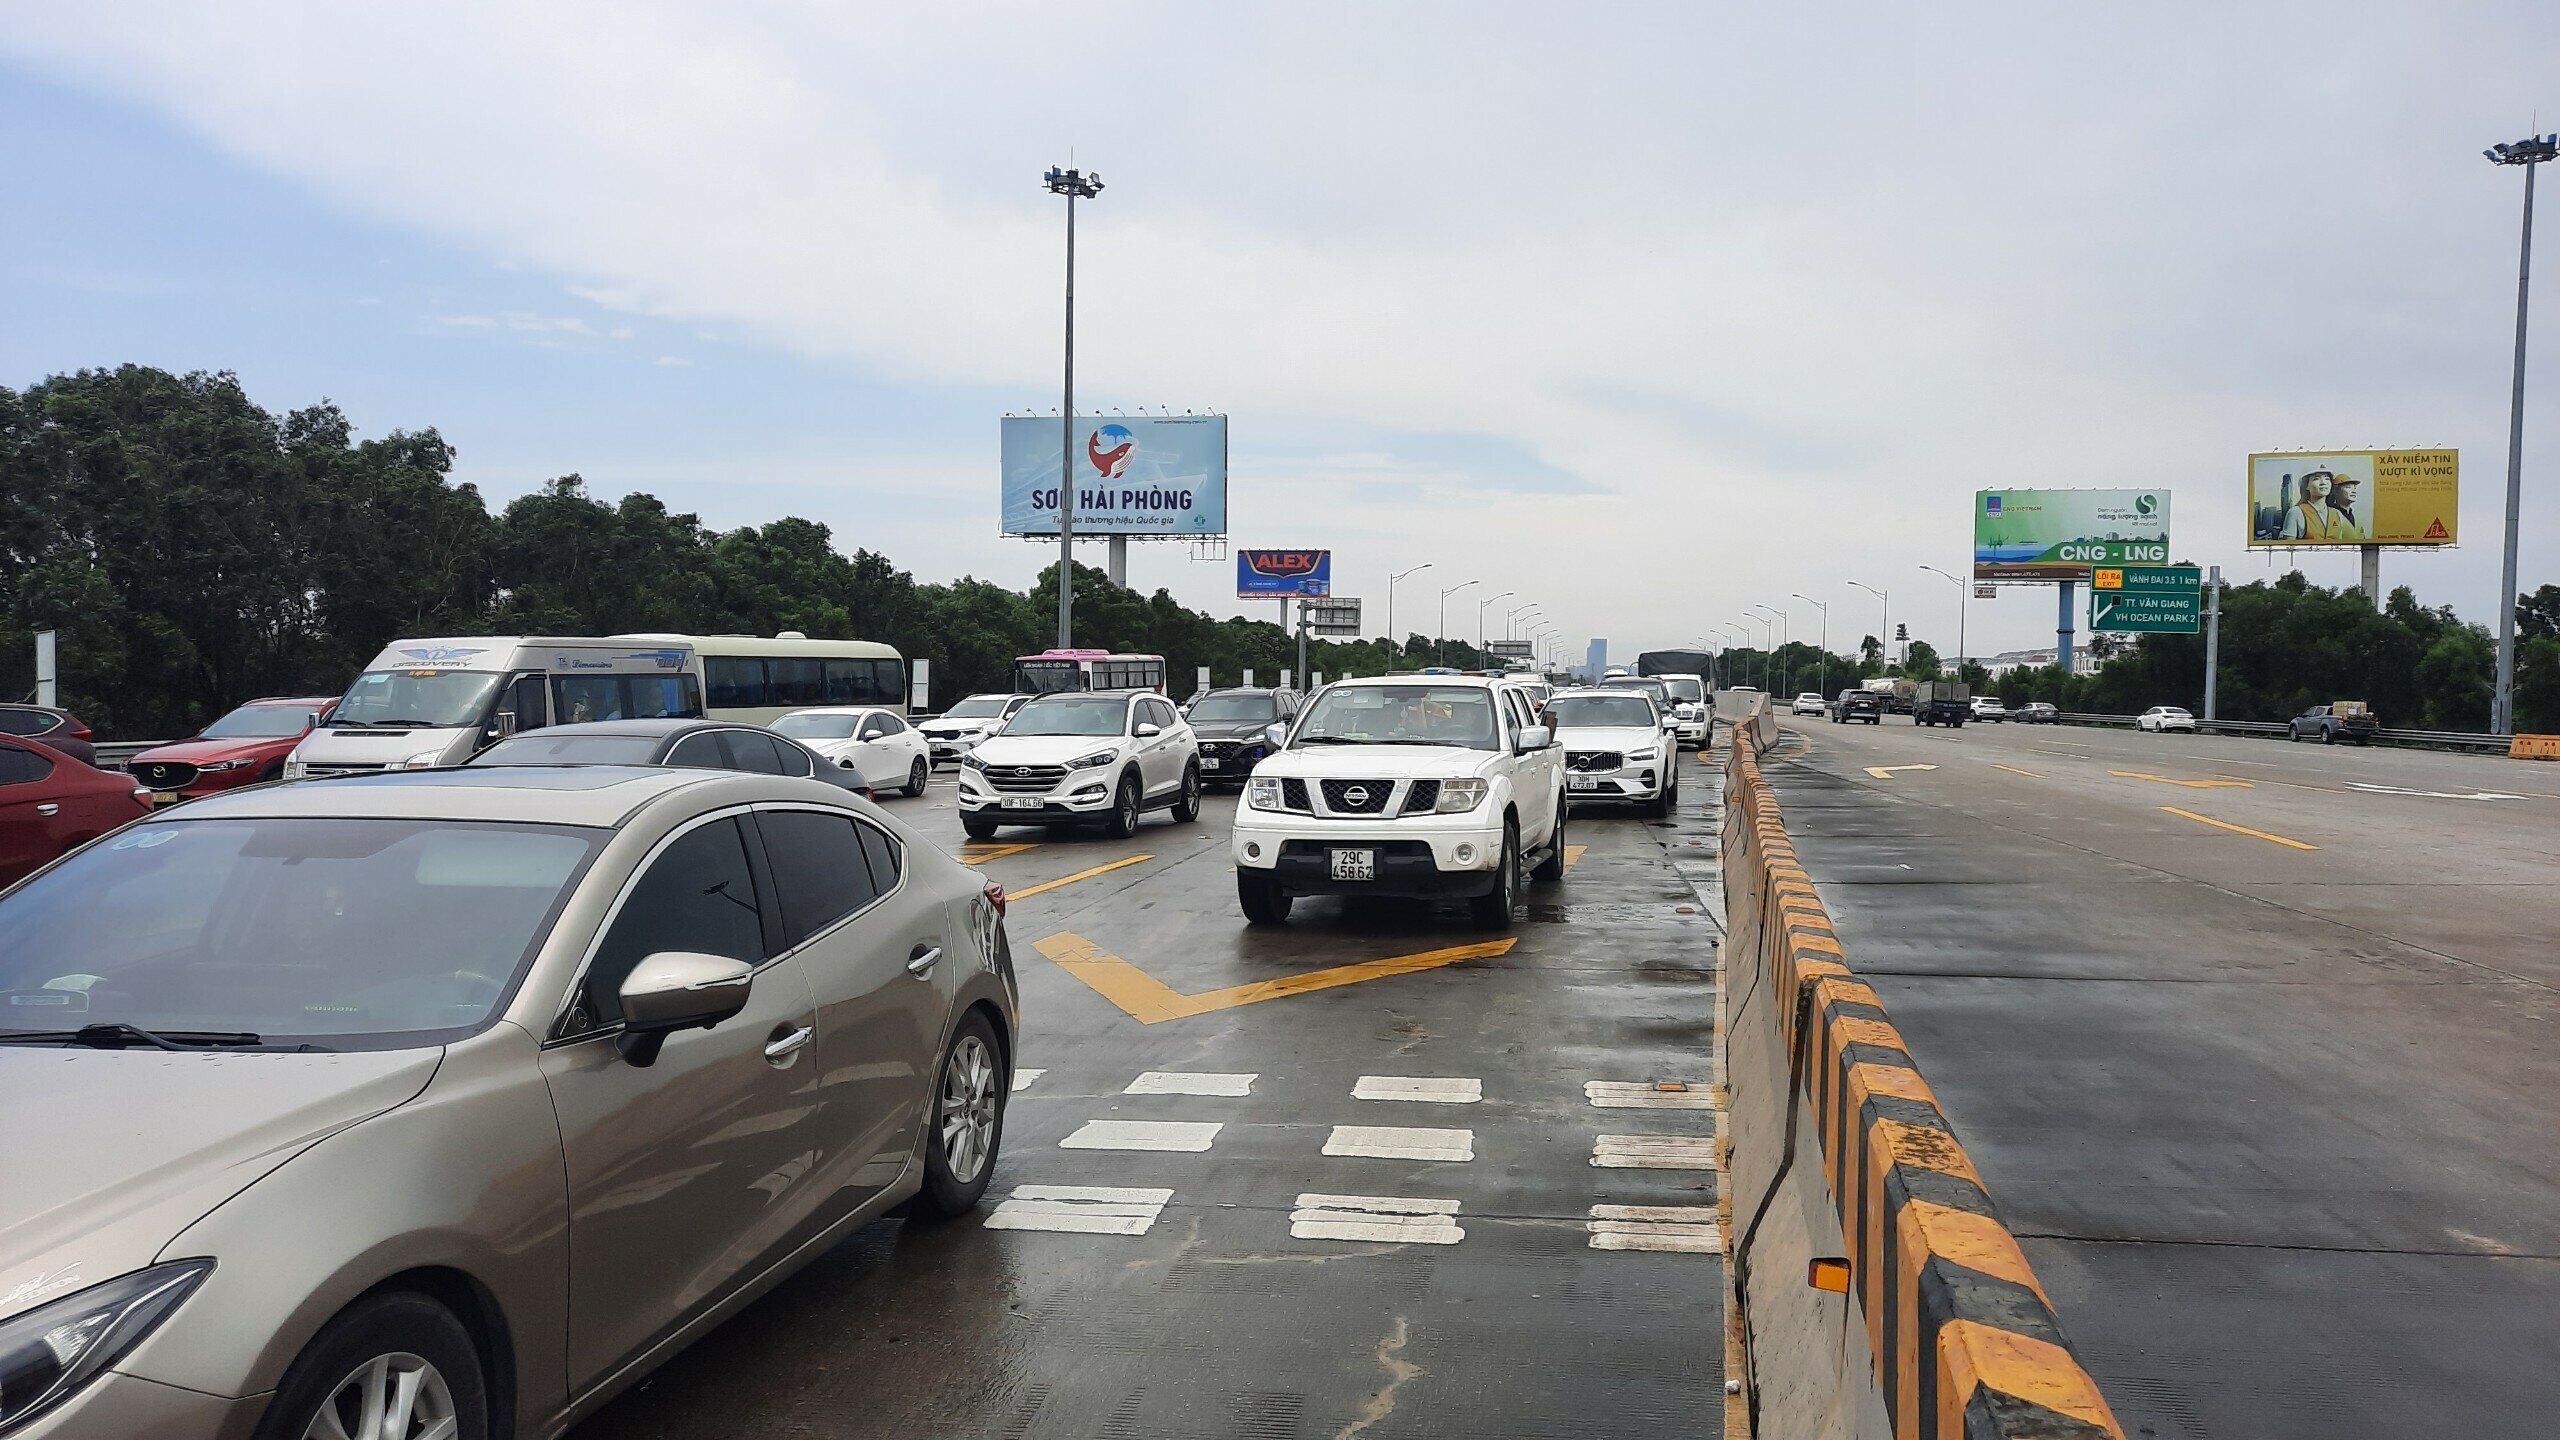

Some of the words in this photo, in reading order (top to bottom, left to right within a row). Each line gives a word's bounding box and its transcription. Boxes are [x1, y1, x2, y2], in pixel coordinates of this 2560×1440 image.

[2433, 455, 2451, 463] TIN
[1032, 487, 1073, 510] SƠ
[1080, 484, 1115, 510] HẢI
[1121, 484, 1193, 510] PHÒNG
[1161, 517, 1174, 525] gia
[2059, 545, 2106, 560] CNG
[2125, 545, 2164, 560] LNG
[1256, 554, 1311, 568] ALEX
[2129, 573, 2149, 584] VÀNH
[2165, 576, 2176, 585] 3.5
[2180, 576, 2183, 584] 1
[2185, 576, 2197, 585] km
[2160, 600, 2190, 609] GIANG
[2115, 613, 2128, 622] VH
[2130, 613, 2162, 622] OCEAN
[2163, 614, 2189, 623] PARK
[2190, 615, 2196, 623] 2
[1341, 851, 1364, 865] 29C
